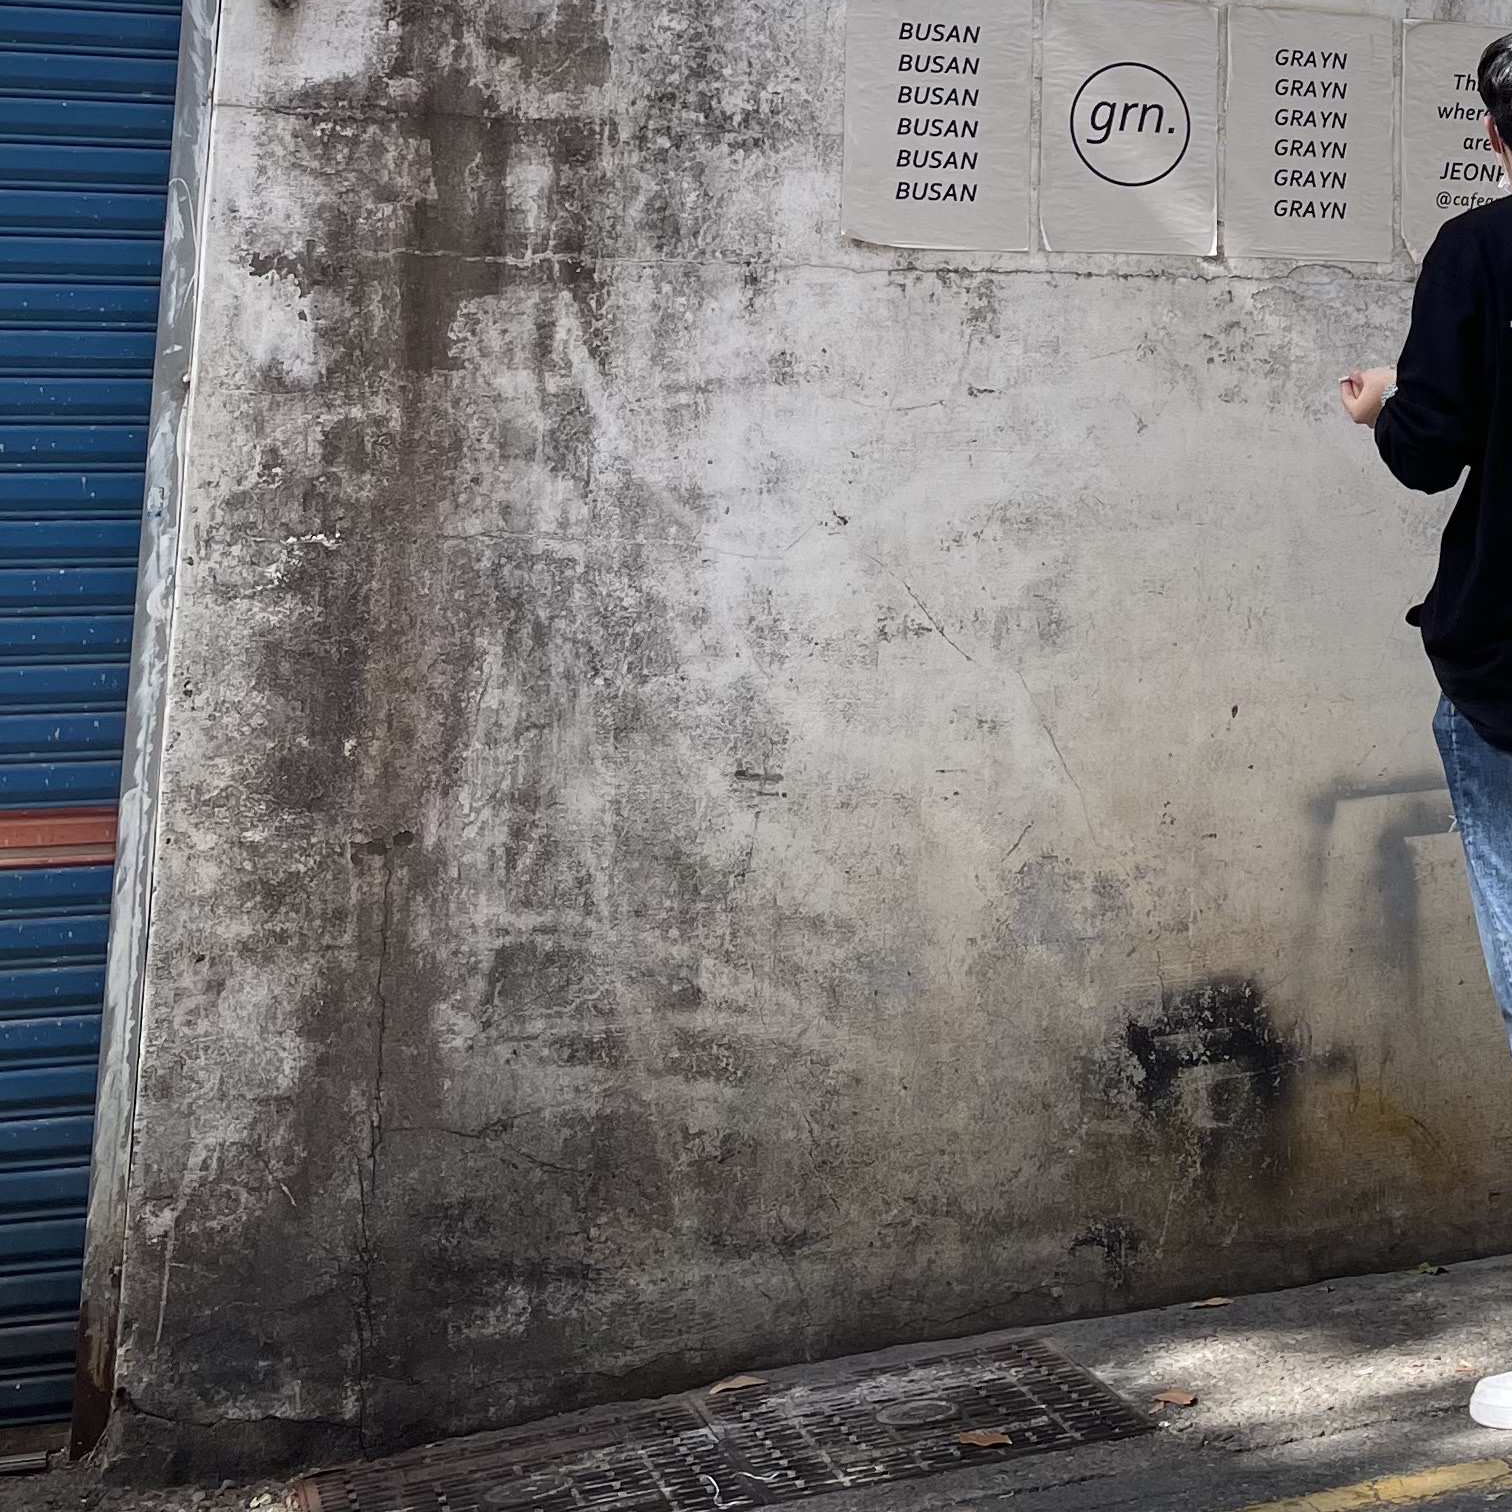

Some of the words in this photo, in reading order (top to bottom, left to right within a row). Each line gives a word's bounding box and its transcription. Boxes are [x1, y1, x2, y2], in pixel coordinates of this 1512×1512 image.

[898, 22, 981, 44] BUSAN
[898, 54, 980, 75] BUSAN
[1275, 48, 1348, 70] GRAYN
[1274, 78, 1348, 100] GRAYN
[1453, 73, 1481, 92] Th
[897, 85, 980, 107] BUSAN
[896, 117, 979, 139] BUSAN
[1086, 101, 1175, 145] grn.
[1274, 108, 1348, 129] GRAYN
[1274, 138, 1348, 159] GRAYN
[896, 149, 979, 170] BUSAN
[1274, 168, 1347, 190] GRAYN
[1440, 162, 1505, 182] JEON
[895, 181, 978, 202] BUSAN
[1274, 199, 1347, 220] GRAYN
